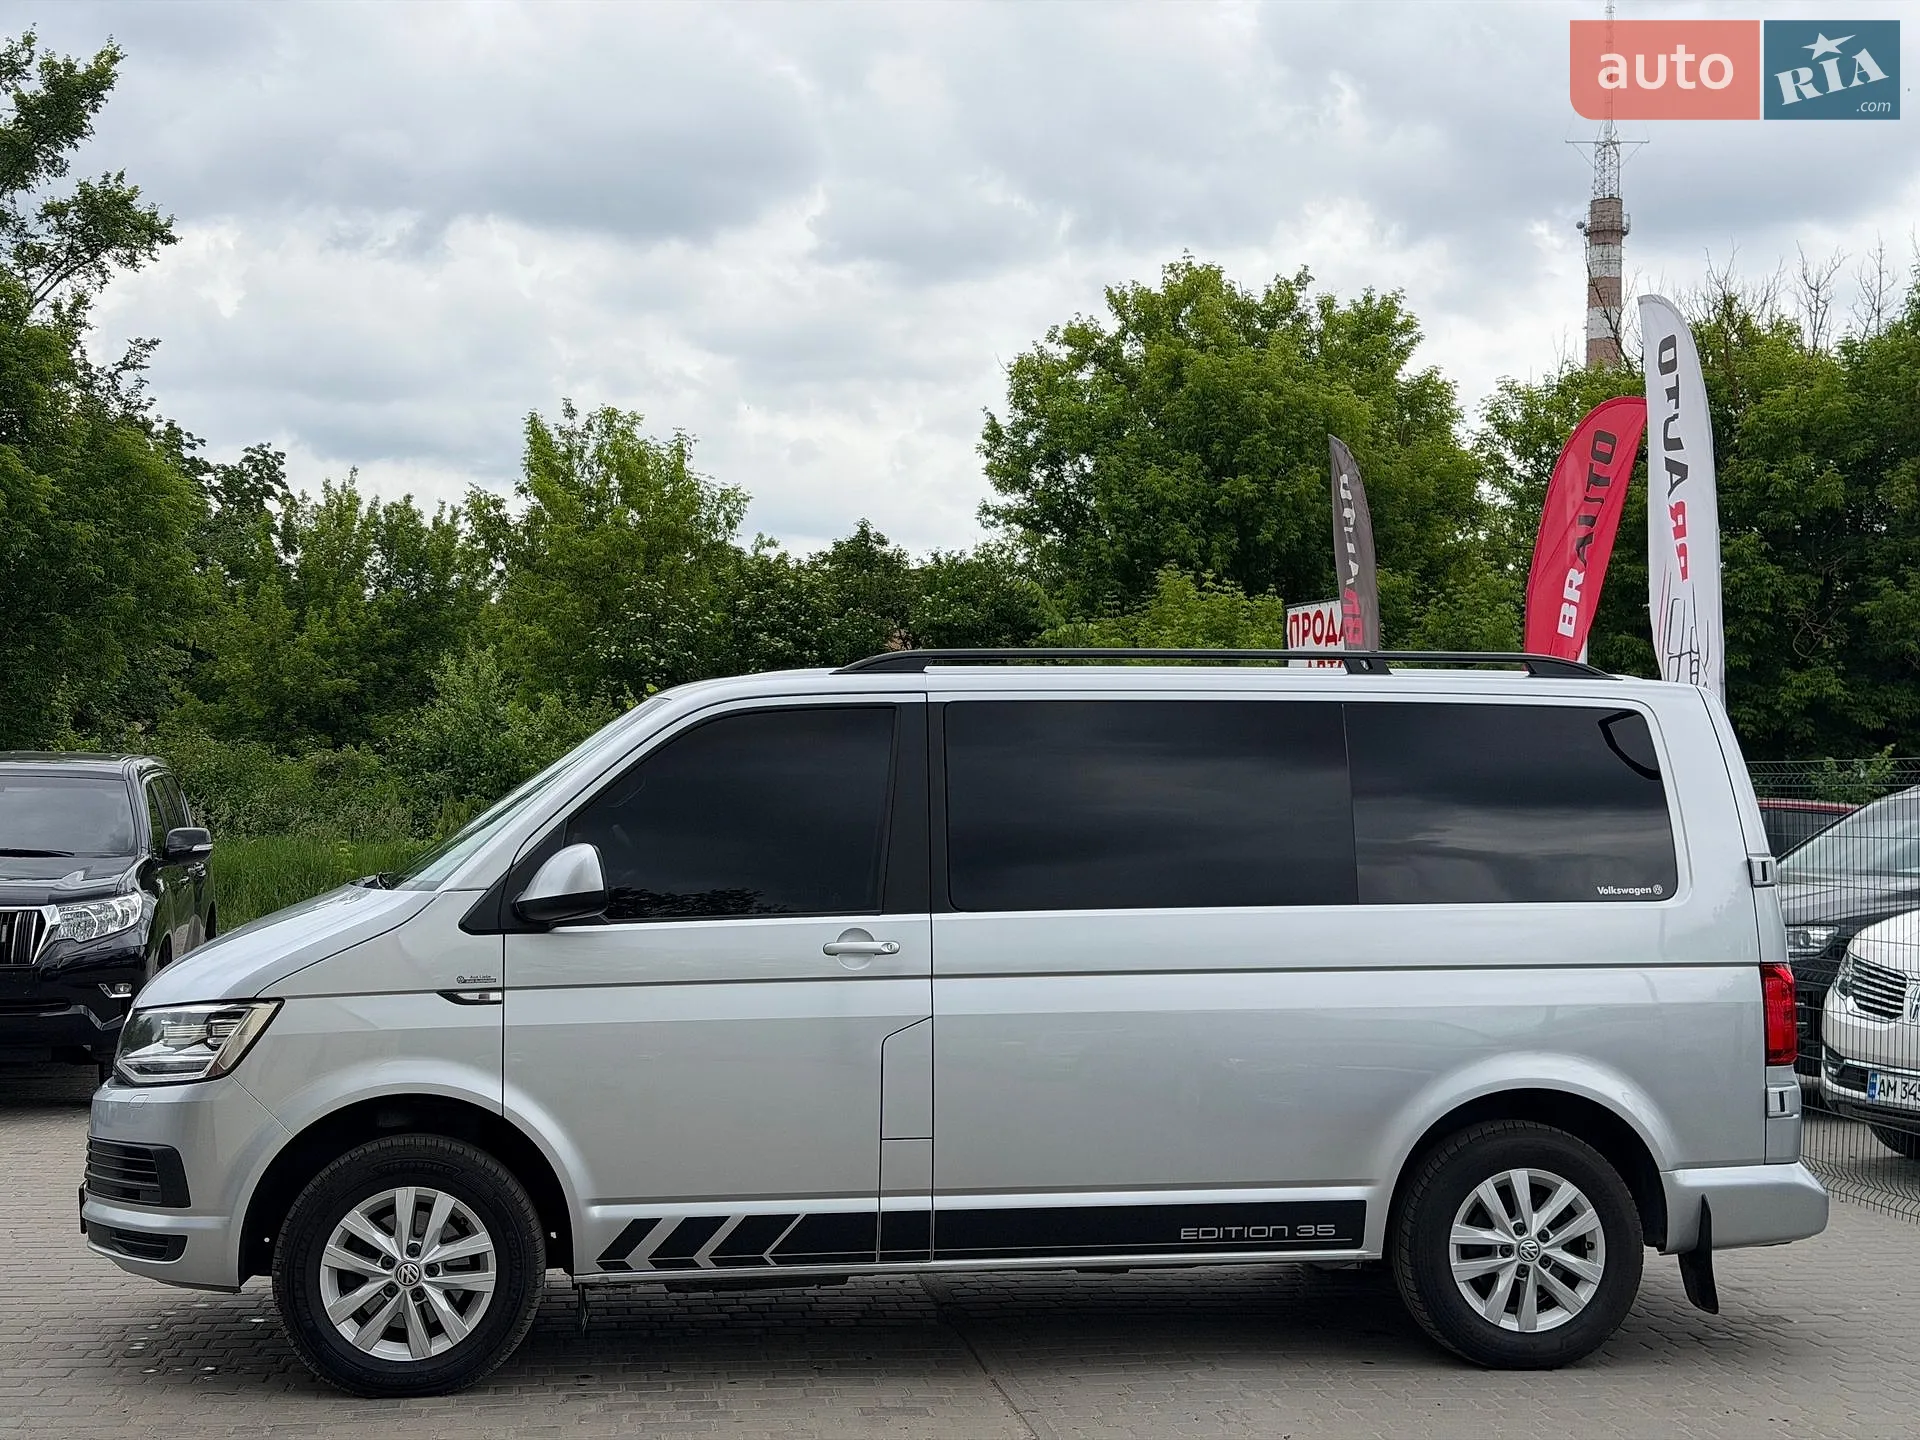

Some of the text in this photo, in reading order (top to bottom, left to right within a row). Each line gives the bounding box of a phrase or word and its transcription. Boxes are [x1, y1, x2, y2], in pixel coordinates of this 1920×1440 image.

[1289, 607, 1344, 648] ПРОД
[1597, 885, 1652, 896] Volkswagen
[1878, 1078, 1898, 1098] AM
[1180, 1224, 1336, 1240] EDITION 35
